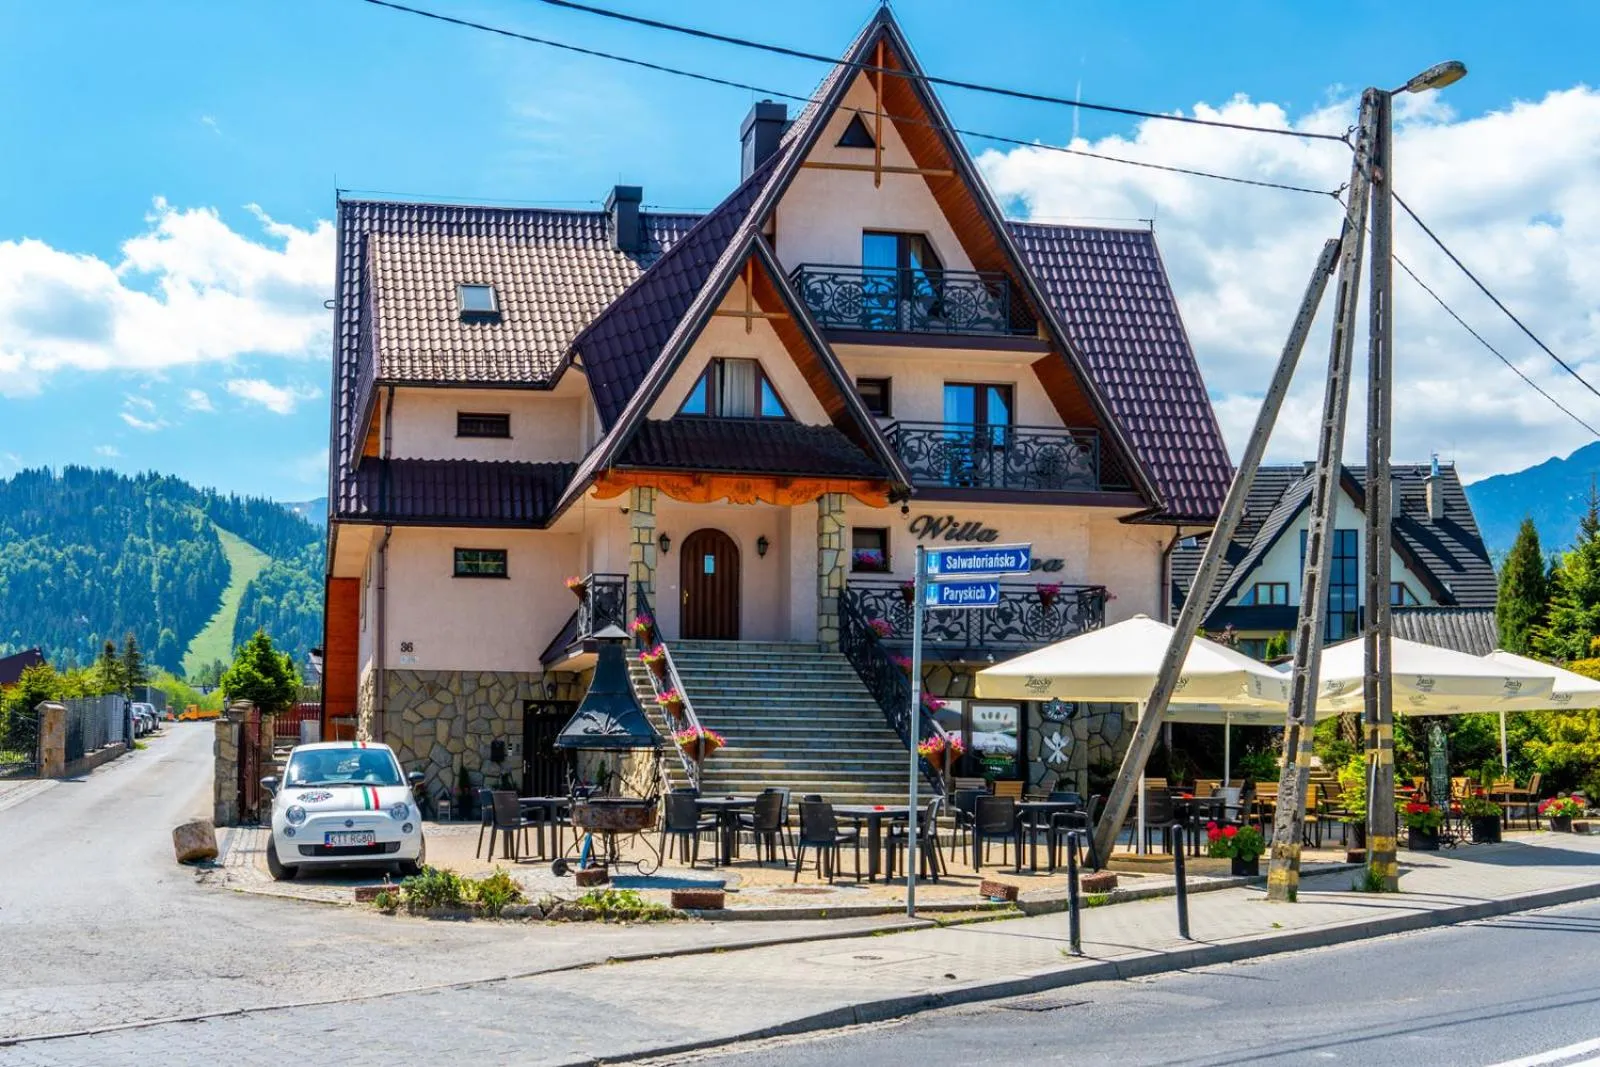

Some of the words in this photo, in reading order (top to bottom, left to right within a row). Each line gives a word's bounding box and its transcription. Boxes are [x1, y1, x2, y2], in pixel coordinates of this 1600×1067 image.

[909, 514, 999, 542] Willa
[946, 553, 1016, 569] Salwatoriańska
[943, 584, 986, 603] Paryskich
[400, 641, 413, 653] 36
[331, 834, 347, 844] KTT
[350, 832, 373, 843] RG80
